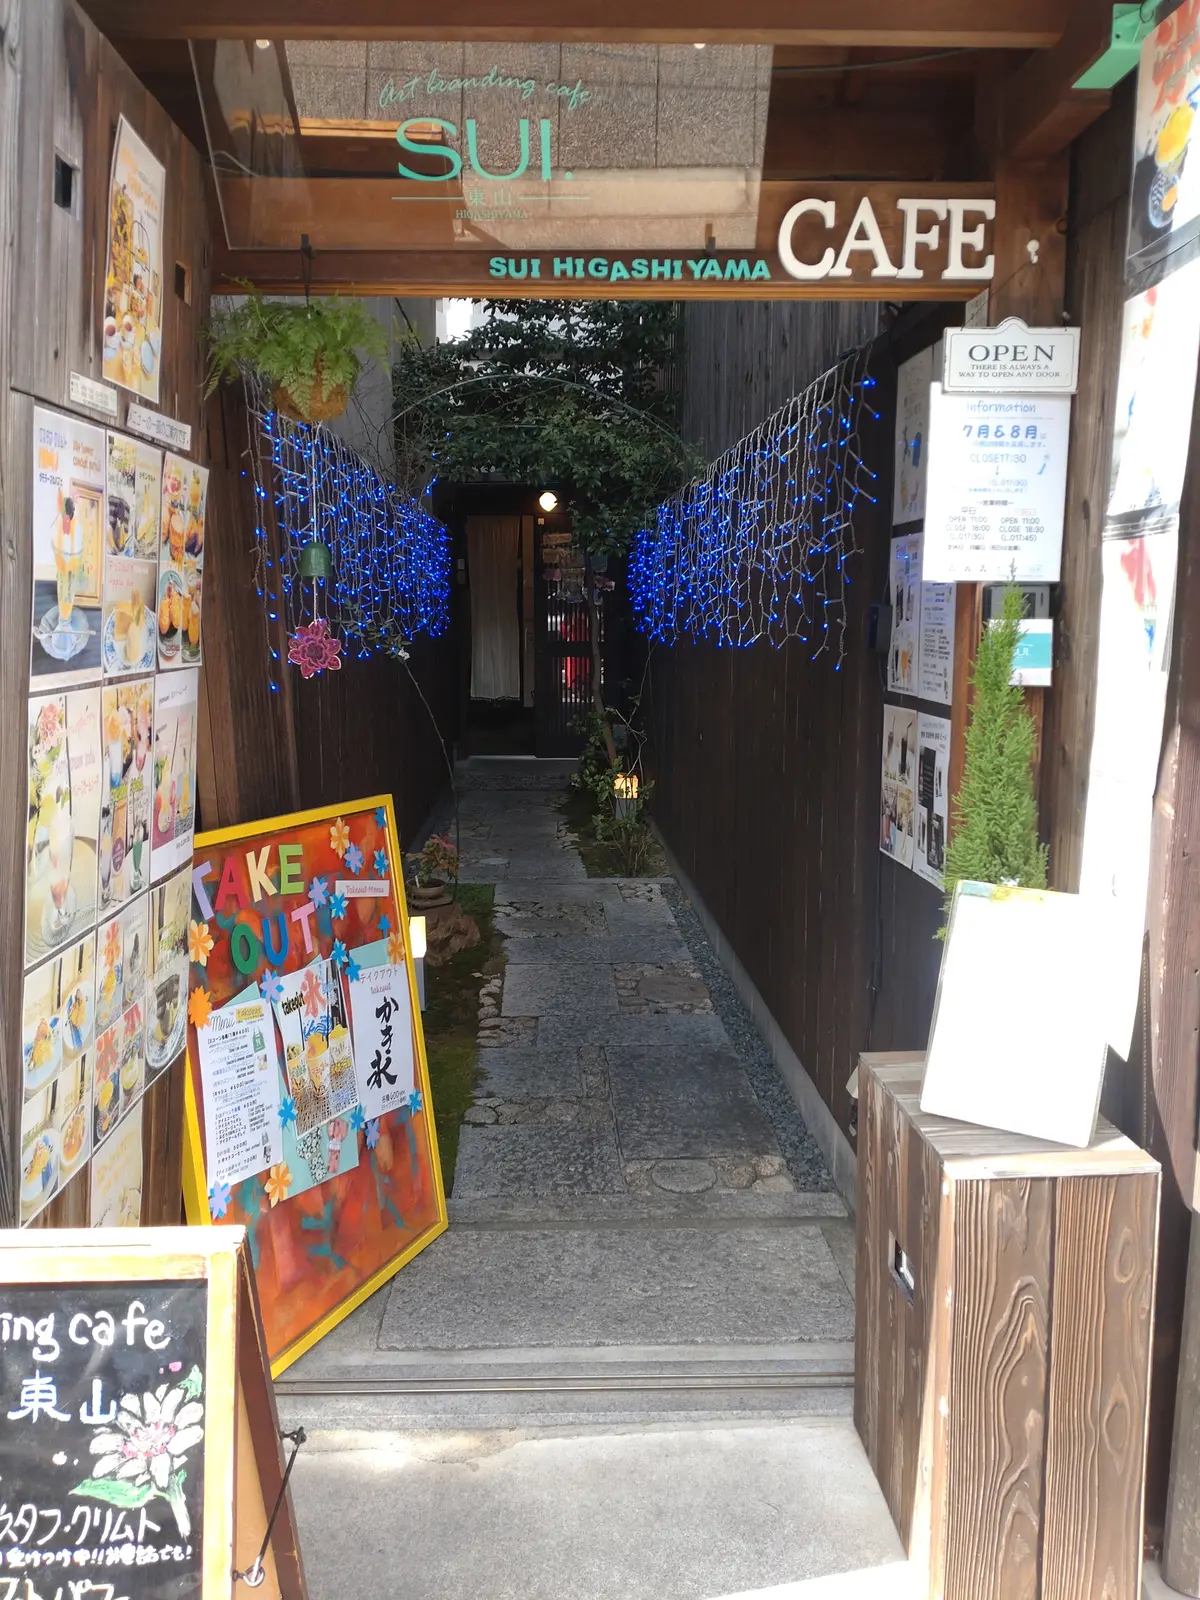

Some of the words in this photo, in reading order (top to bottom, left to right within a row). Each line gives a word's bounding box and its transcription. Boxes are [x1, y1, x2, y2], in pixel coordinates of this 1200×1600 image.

[379, 78, 420, 109] Art
[427, 65, 536, 100] branding
[545, 79, 593, 111] cafe
[396, 117, 575, 181] SUI.
[467, 187, 514, 206] 東山
[455, 209, 530, 219] HIGASHIYAMA
[778, 197, 996, 281] CAFE
[488, 257, 541, 280] SUI
[553, 256, 772, 282] HIGASHIYAMA
[968, 344, 1055, 361] OPEN
[945, 524, 967, 532] CLOSE
[971, 524, 990, 532] 18:00
[1022, 517, 1040, 525] 11:00
[192, 844, 305, 921] TAKE
[230, 902, 316, 975] OUT
[281, 991, 305, 1016] takeout
[211, 1015, 236, 1032] Menu
[68, 1300, 172, 1350] cafe
[7, 1369, 118, 1425] 東山
